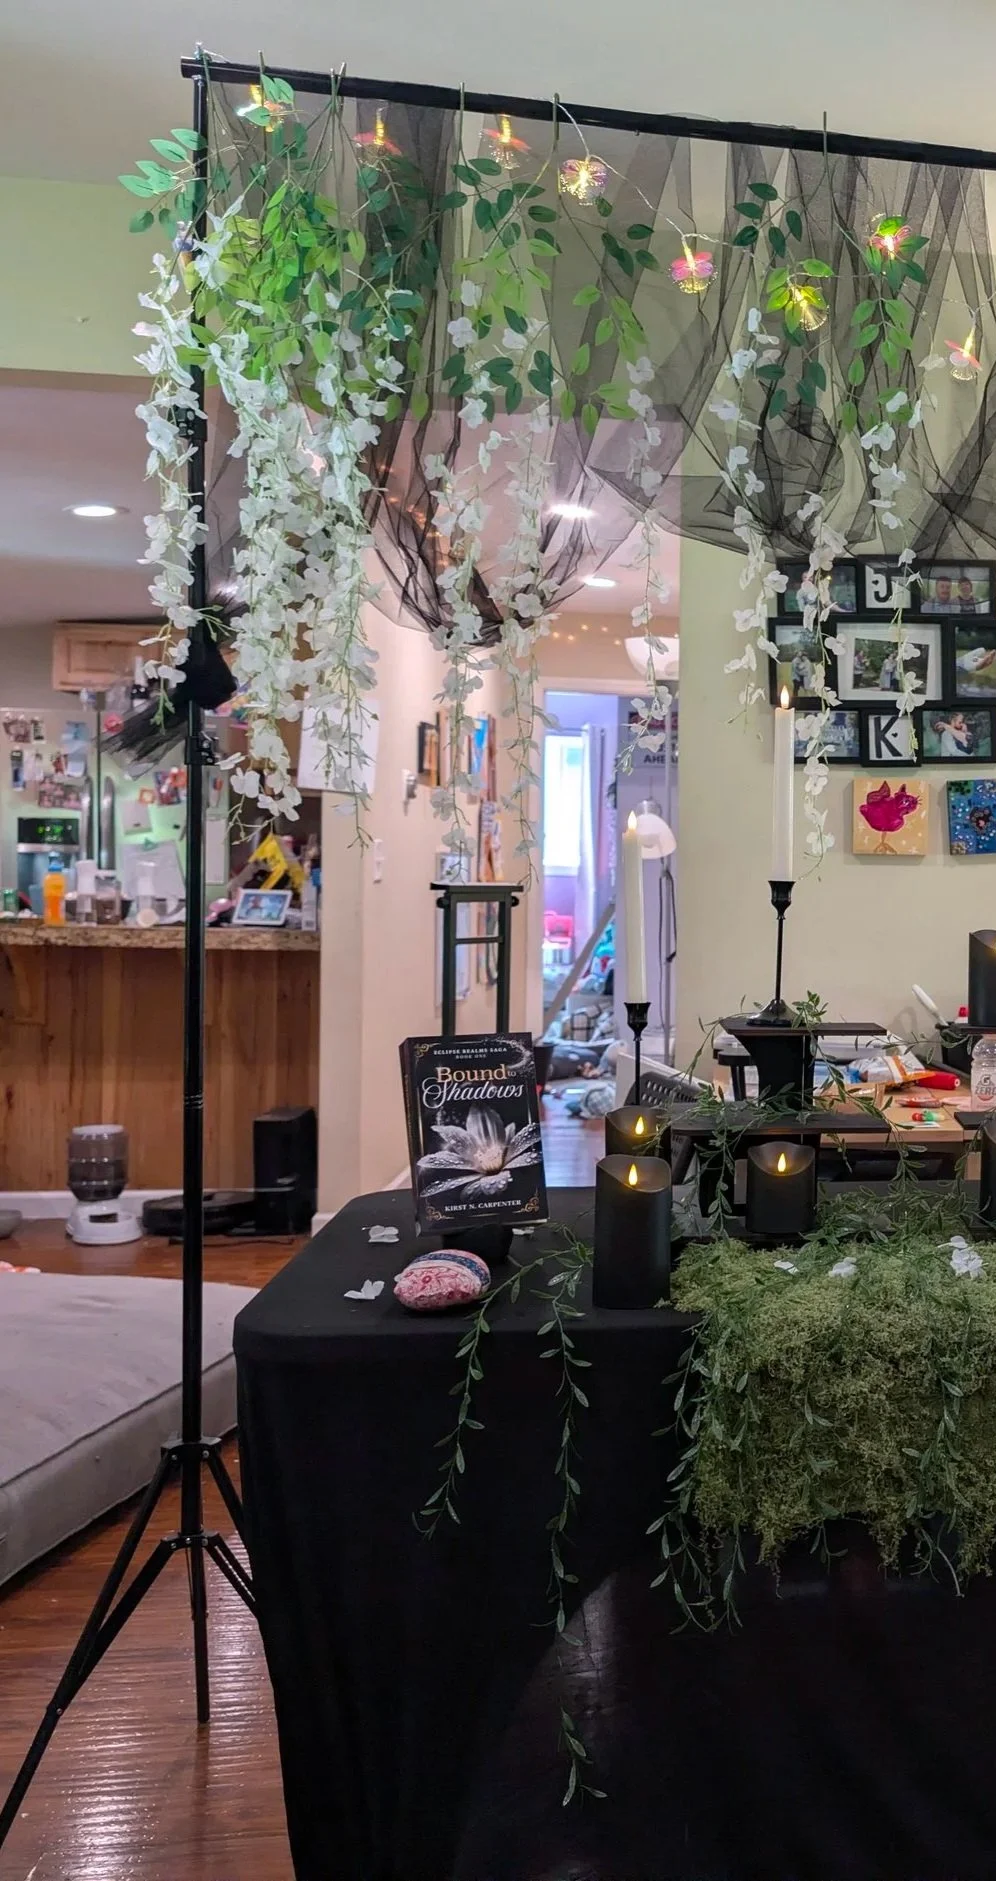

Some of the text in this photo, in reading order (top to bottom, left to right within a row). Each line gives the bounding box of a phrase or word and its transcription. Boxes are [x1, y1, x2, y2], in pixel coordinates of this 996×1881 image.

[873, 568, 893, 603] J
[873, 716, 902, 758] K
[435, 1063, 507, 1083] Bound
[980, 1074, 992, 1086] G
[422, 1077, 524, 1109] Shadows
[444, 1204, 467, 1212] KIRST
[478, 1200, 522, 1208] CARPENTER
